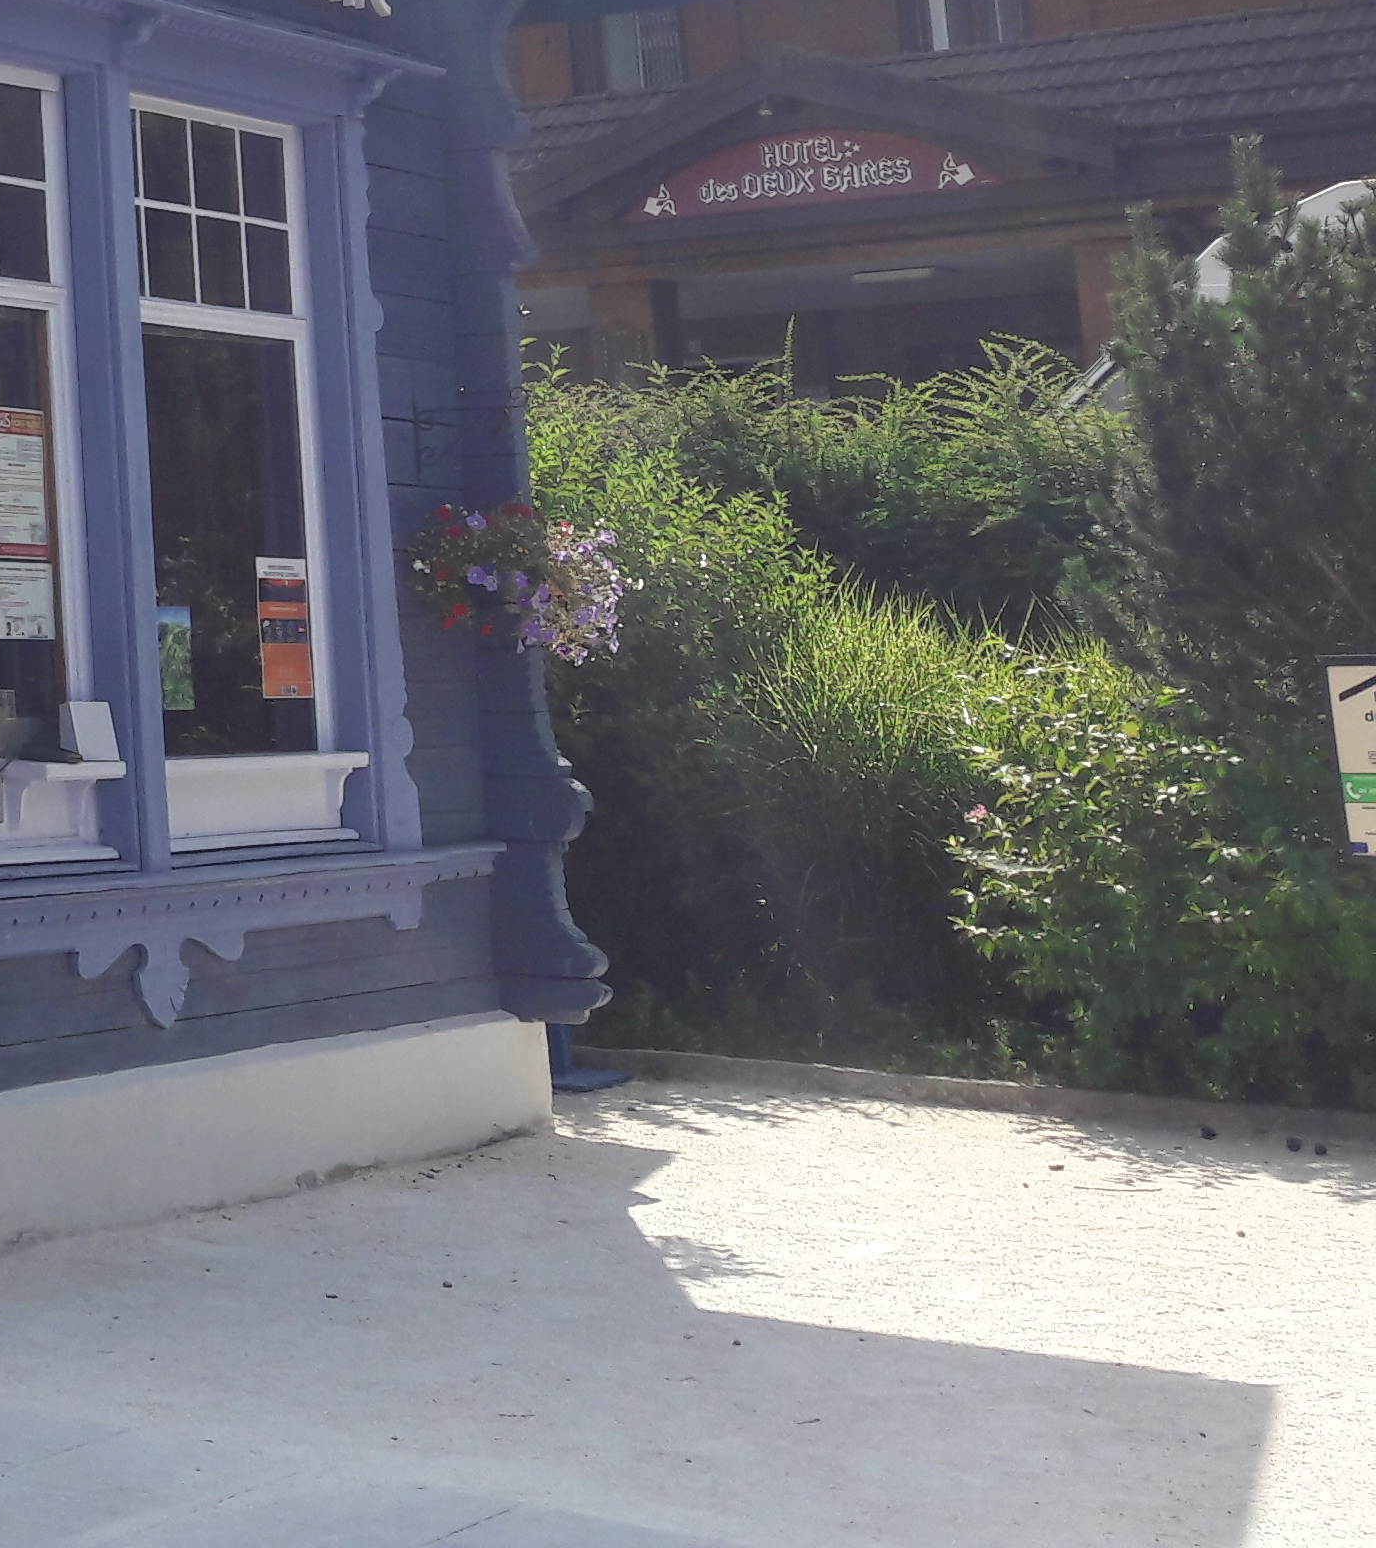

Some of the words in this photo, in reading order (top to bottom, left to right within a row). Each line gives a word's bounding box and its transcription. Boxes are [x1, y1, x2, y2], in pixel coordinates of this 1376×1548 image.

[759, 135, 844, 169] HOTEL
[699, 177, 739, 204] des
[741, 167, 817, 199] DEUX
[819, 155, 913, 193] GARES
